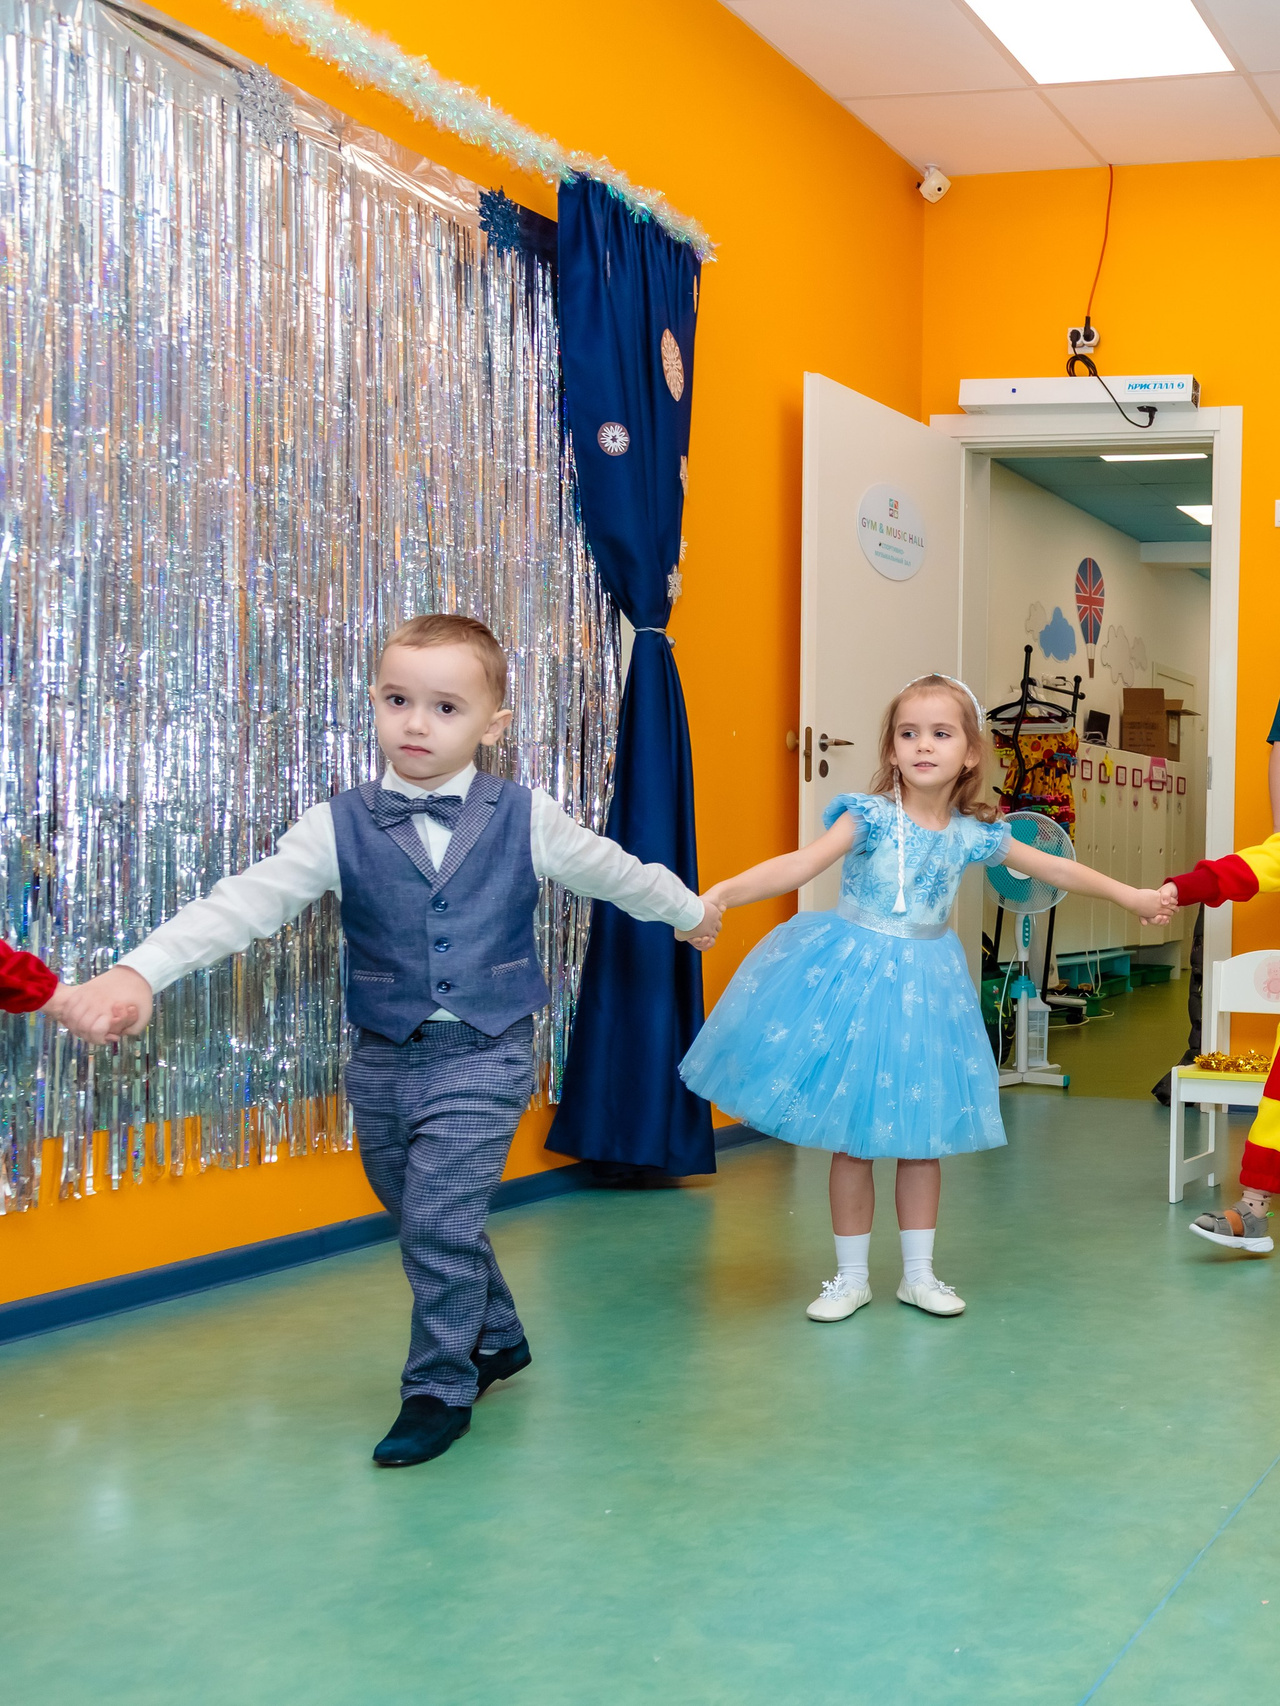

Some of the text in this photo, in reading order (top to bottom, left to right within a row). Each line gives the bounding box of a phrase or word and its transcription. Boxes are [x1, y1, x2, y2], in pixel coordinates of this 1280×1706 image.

[1127, 382, 1174, 390] КРИСТАЛЛ
[861, 517, 924, 547] GYM & MUSIC HALL
